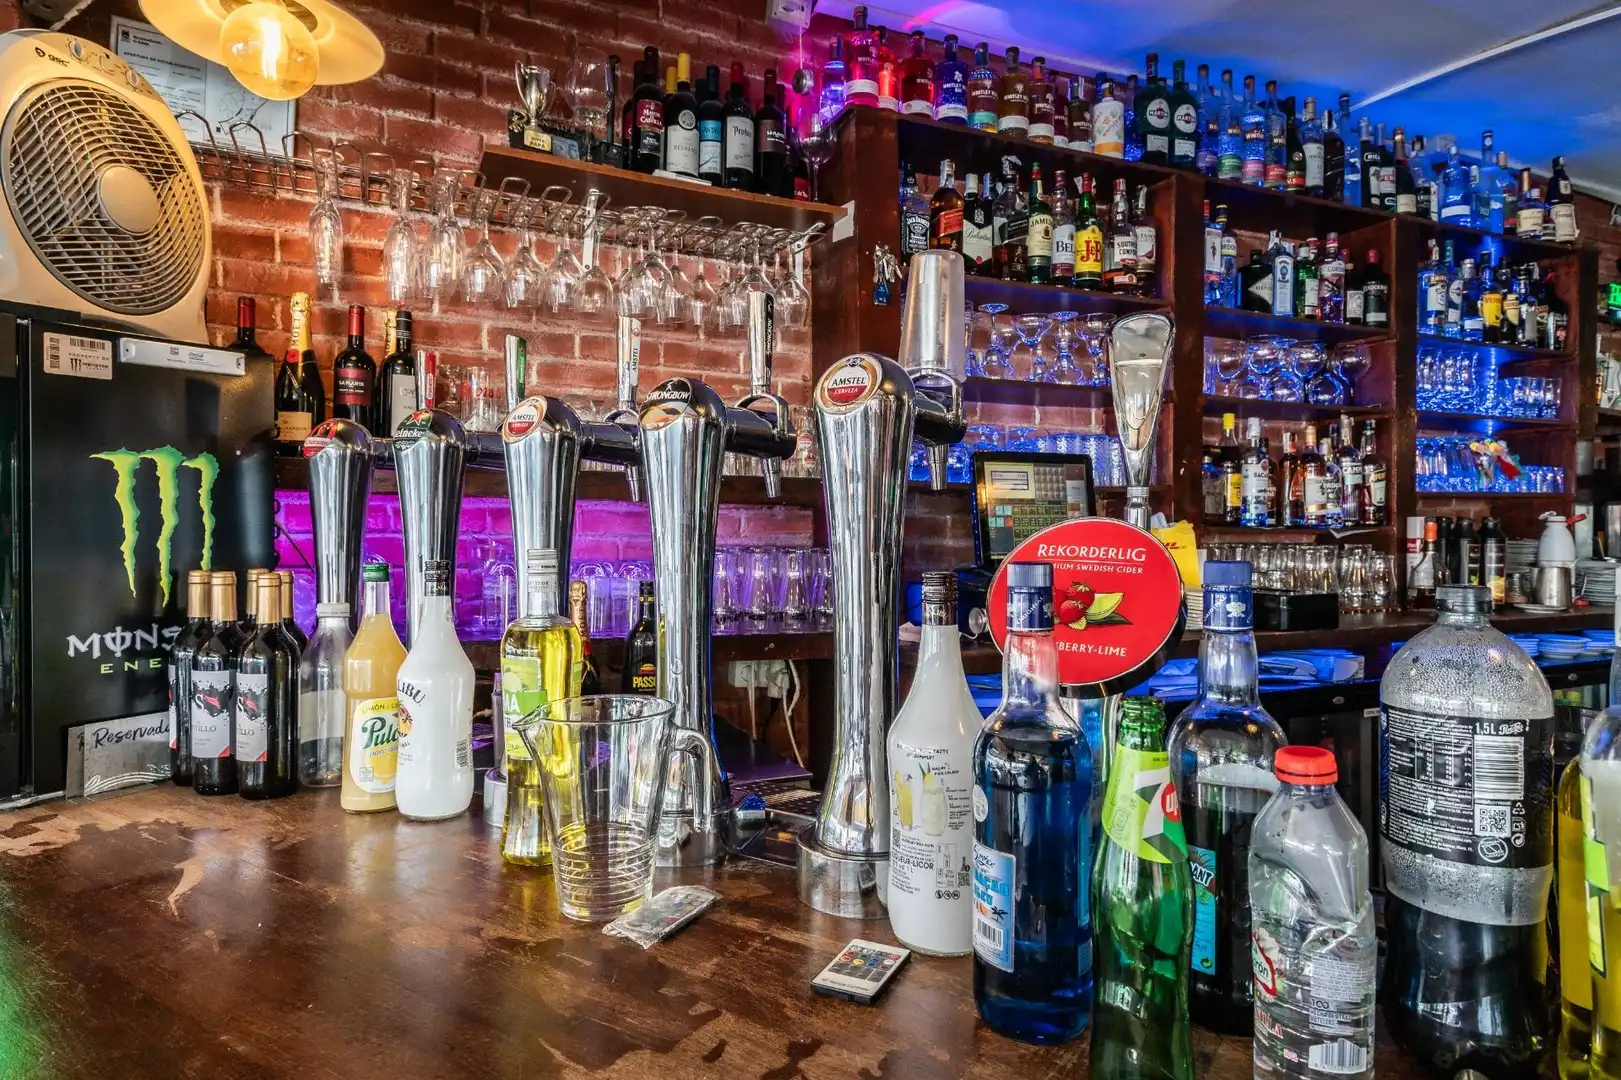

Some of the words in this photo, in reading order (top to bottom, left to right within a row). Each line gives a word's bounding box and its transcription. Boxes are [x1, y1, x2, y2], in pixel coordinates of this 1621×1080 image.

[1030, 218, 1053, 227] JAMES
[1080, 240, 1102, 263] J&B
[831, 376, 867, 387] AMSTEL
[644, 390, 690, 402] STRONGBOW
[834, 386, 858, 394] CERVEZA
[1037, 544, 1146, 562] REKORDERLIG
[1076, 564, 1114, 573] SWEDISH
[1116, 566, 1143, 574] CIDER
[66, 623, 182, 659] MONS
[1056, 642, 1127, 657] BERRY-LIME
[100, 658, 162, 674] ENE
[397, 680, 426, 706] LIBU
[361, 716, 399, 750] Pulc
